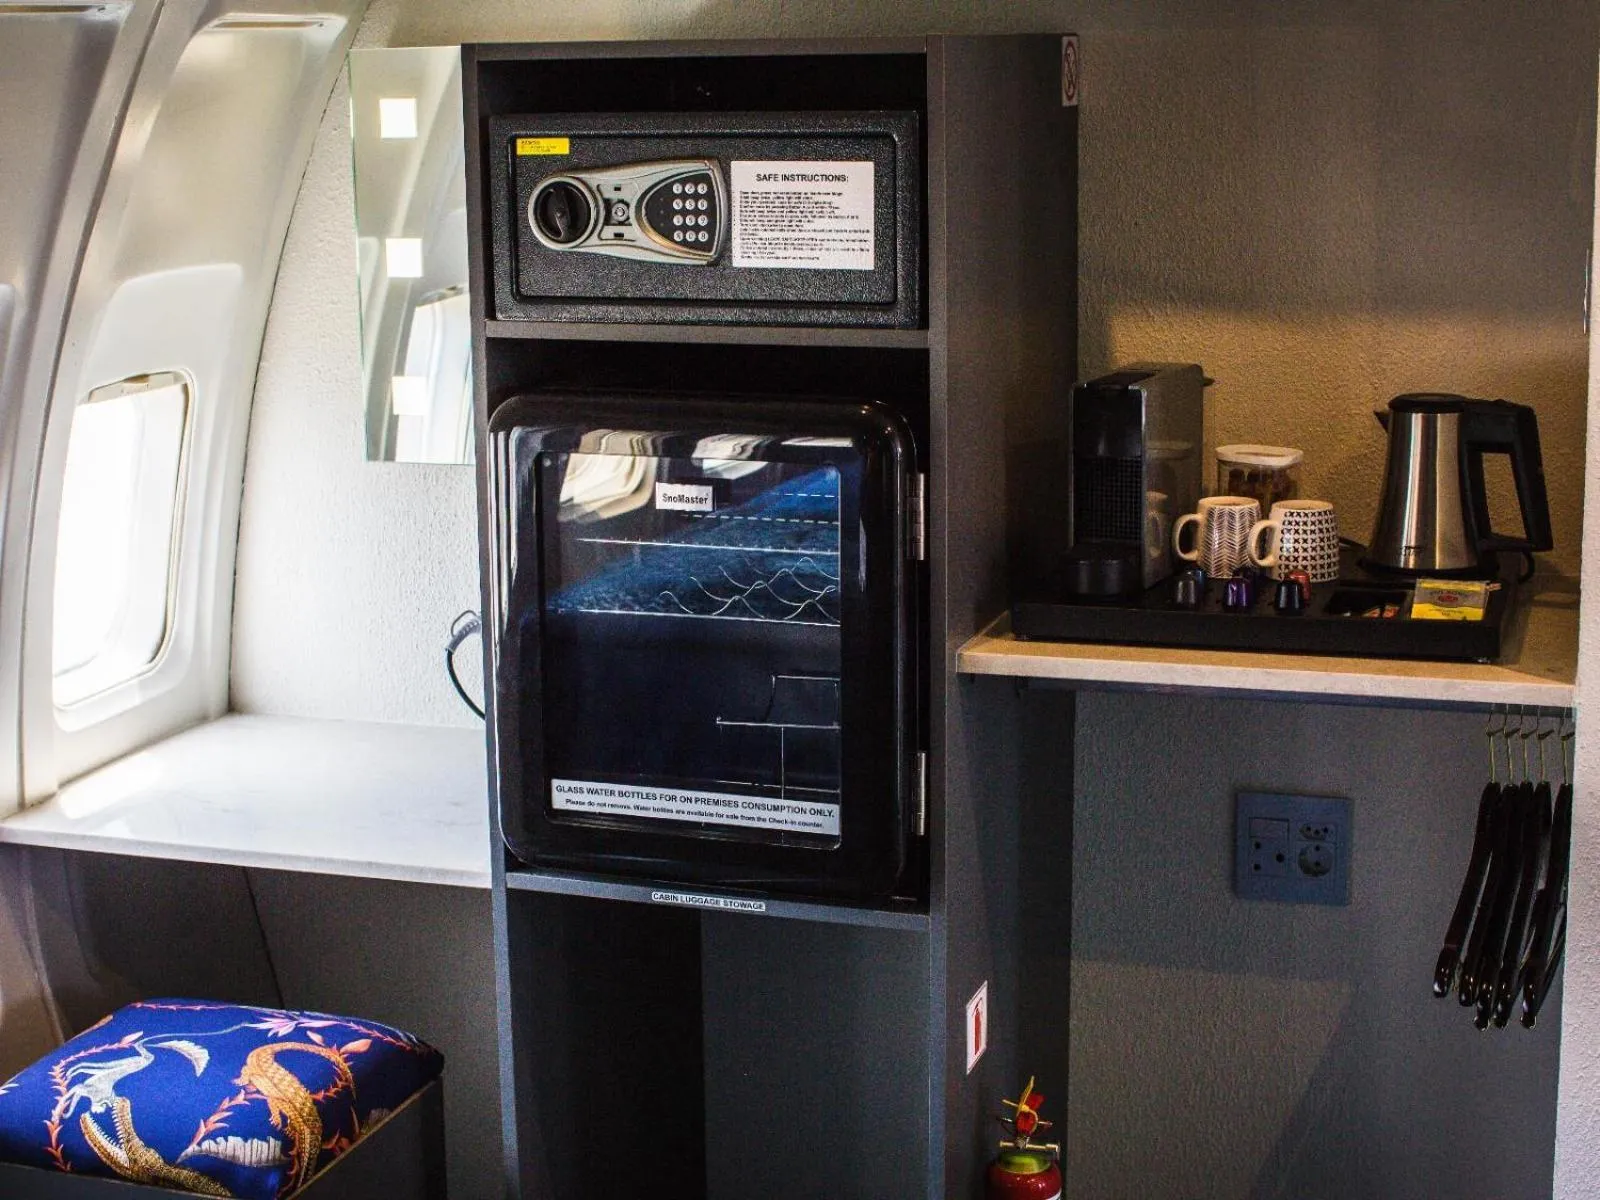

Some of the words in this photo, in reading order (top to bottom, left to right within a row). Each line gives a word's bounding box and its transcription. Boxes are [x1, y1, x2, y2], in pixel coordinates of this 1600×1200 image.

[755, 173, 779, 182] SAFE
[781, 174, 849, 183] INSTRUCTIONS:
[662, 492, 709, 504] SnoMaster
[555, 784, 585, 795] GLASS
[586, 787, 616, 797] WATER
[618, 790, 658, 801] BOTTLES
[659, 793, 677, 803] FOR
[679, 795, 693, 805] ON
[694, 797, 739, 809] PREMISES
[741, 801, 808, 815] CONSUMPTION
[808, 807, 835, 818] ONLY.
[565, 798, 586, 806] Please
[633, 804, 651, 812] Water
[652, 806, 674, 814] bottles
[687, 809, 714, 818] available
[725, 812, 739, 820] sale
[740, 814, 756, 822] from
[653, 892, 679, 902] CABIN
[680, 895, 722, 906] LUGGAGE
[723, 899, 765, 910] STOWAGE
